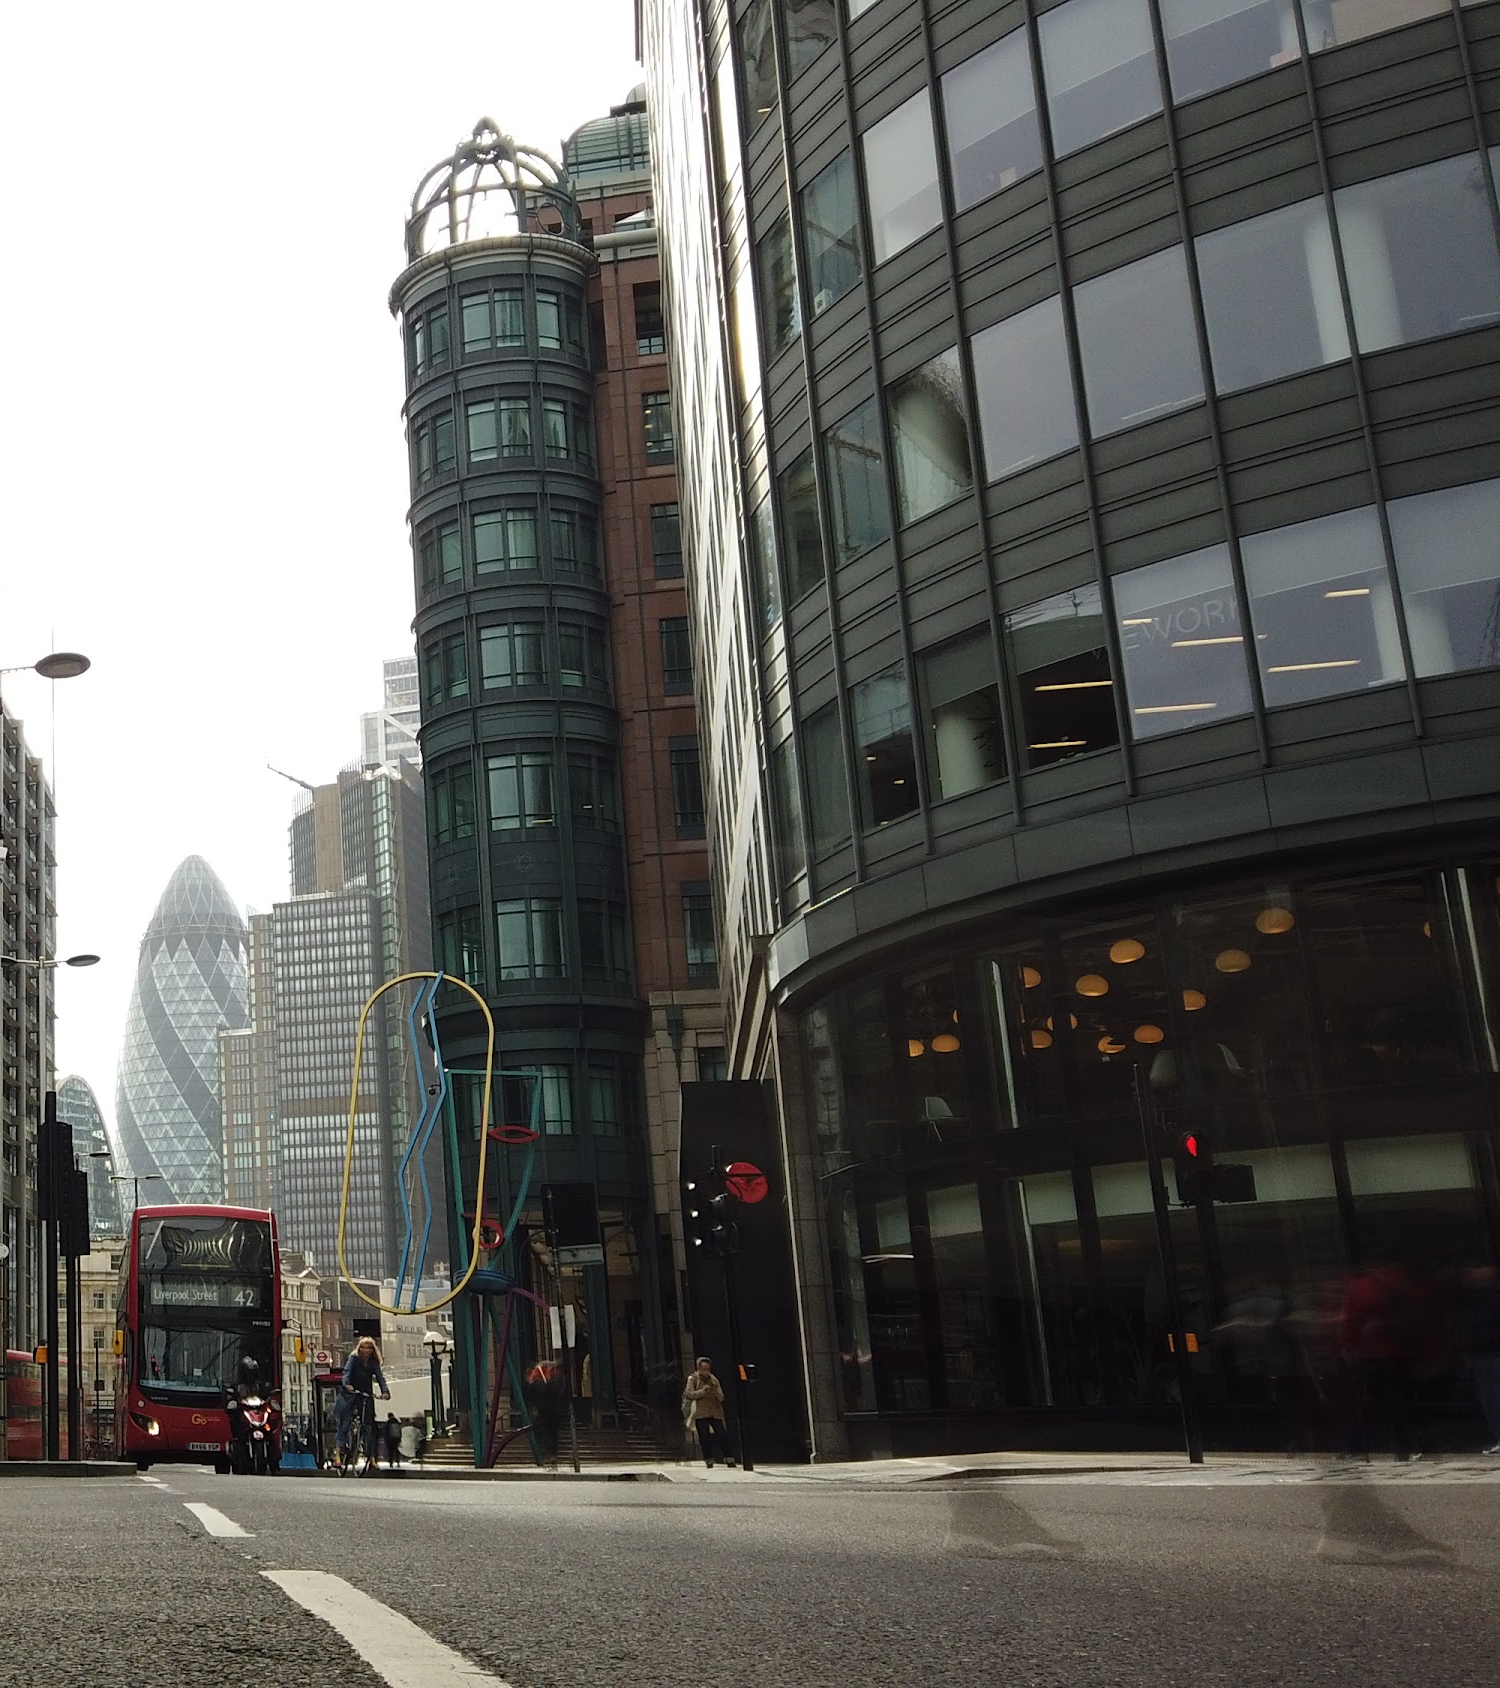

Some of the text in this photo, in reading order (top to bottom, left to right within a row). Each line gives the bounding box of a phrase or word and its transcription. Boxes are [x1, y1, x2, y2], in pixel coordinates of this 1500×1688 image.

[154, 1288, 217, 1302] Liverpool Street
[234, 1289, 254, 1307] 42
